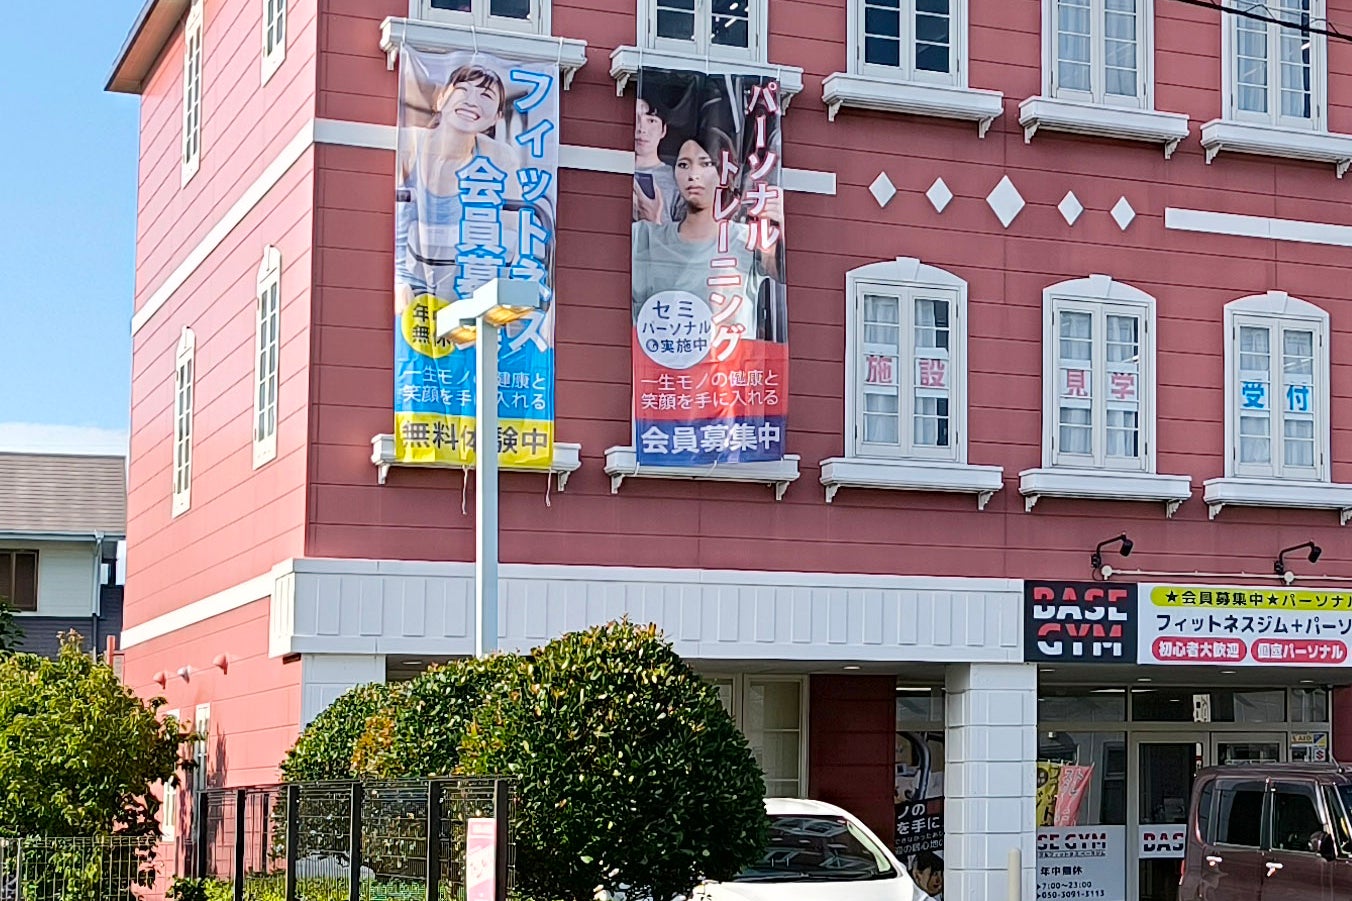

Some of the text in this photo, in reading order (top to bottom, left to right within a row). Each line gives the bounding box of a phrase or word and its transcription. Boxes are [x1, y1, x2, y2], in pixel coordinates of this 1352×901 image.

[746, 81, 780, 250] パーソナル
[707, 150, 746, 362] トレーニング
[652, 300, 694, 320] セミ
[642, 320, 712, 336] パーソナル
[402, 365, 546, 390] 一生モノ健康と
[640, 369, 779, 390] 一生モノの健康と
[402, 384, 546, 410] 笑顔を手入れる
[641, 389, 779, 411] 笑顔を手に入れる
[1240, 381, 1310, 413] 受付
[641, 421, 780, 454] 会員募集中
[1033, 586, 1128, 621] BASE
[1037, 622, 1123, 657] GYM
[1158, 641, 1240, 659] 初心者大歓迎
[1257, 643, 1344, 660] 個室パーソナル
